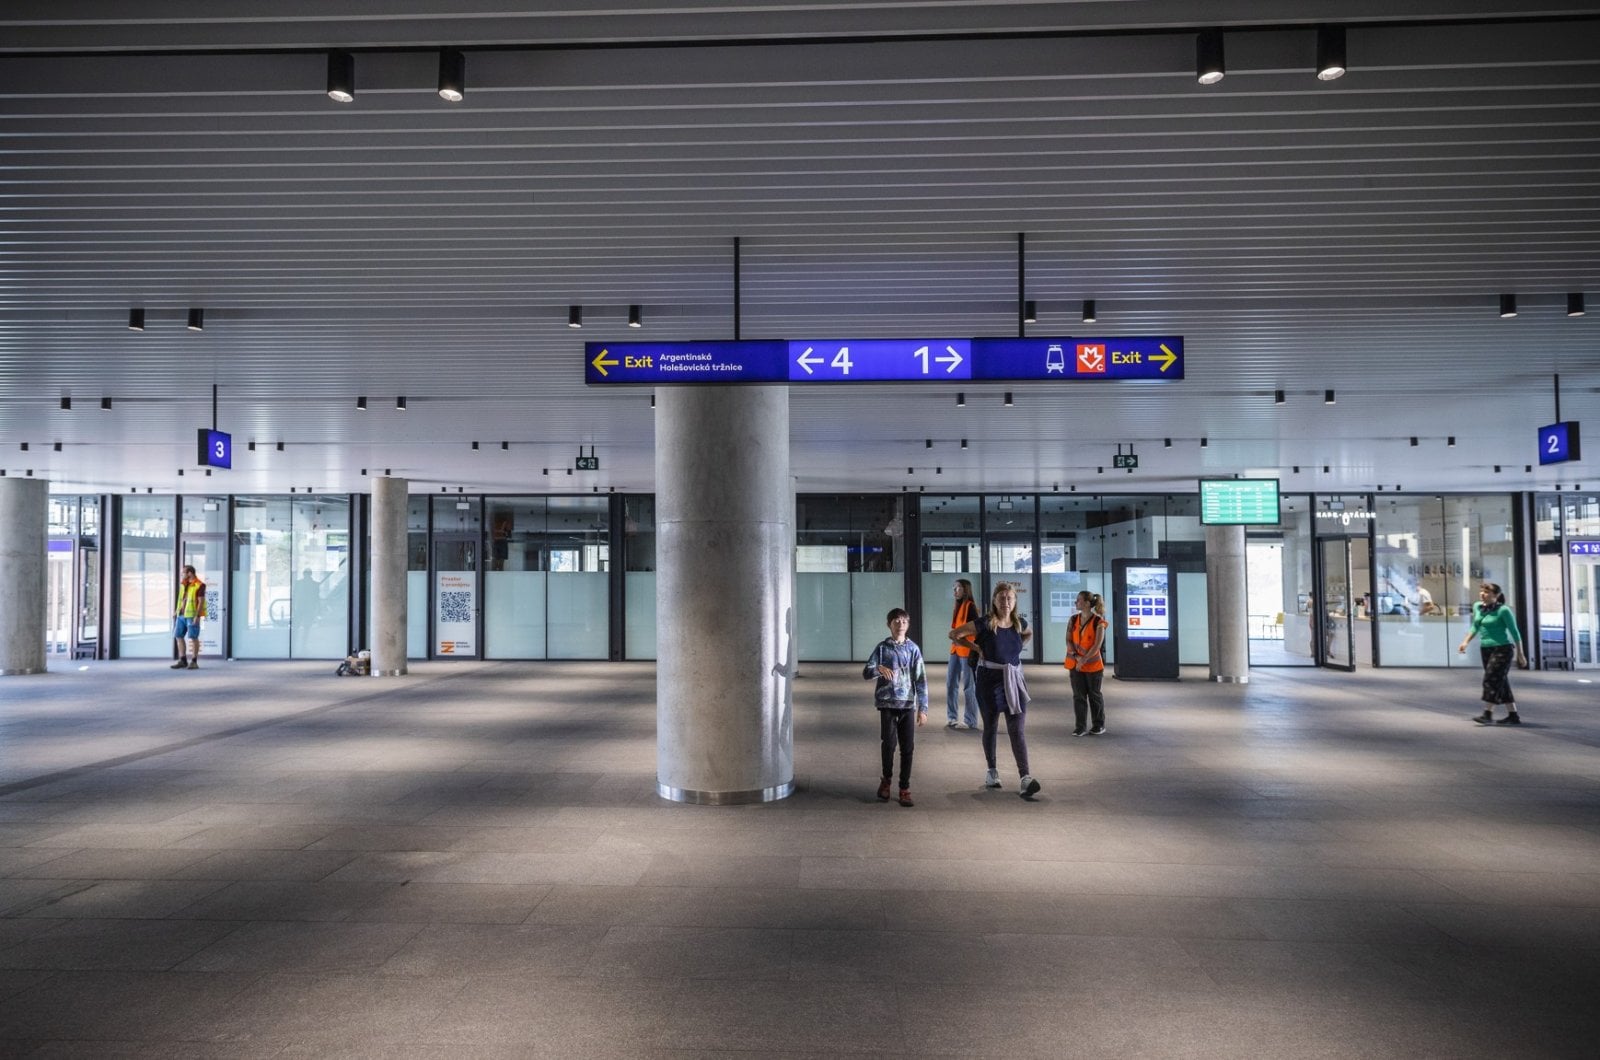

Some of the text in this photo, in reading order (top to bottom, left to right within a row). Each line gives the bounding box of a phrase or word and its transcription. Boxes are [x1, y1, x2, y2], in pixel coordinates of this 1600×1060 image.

[624, 356, 653, 368] Exit
[659, 353, 712, 362] Argentinská
[830, 347, 854, 375] 4
[913, 346, 929, 374] 1
[1111, 351, 1142, 364] Exit
[659, 363, 743, 372] Holešovická tržnice
[215, 440, 225, 458] 3
[1547, 435, 1560, 454] 2
